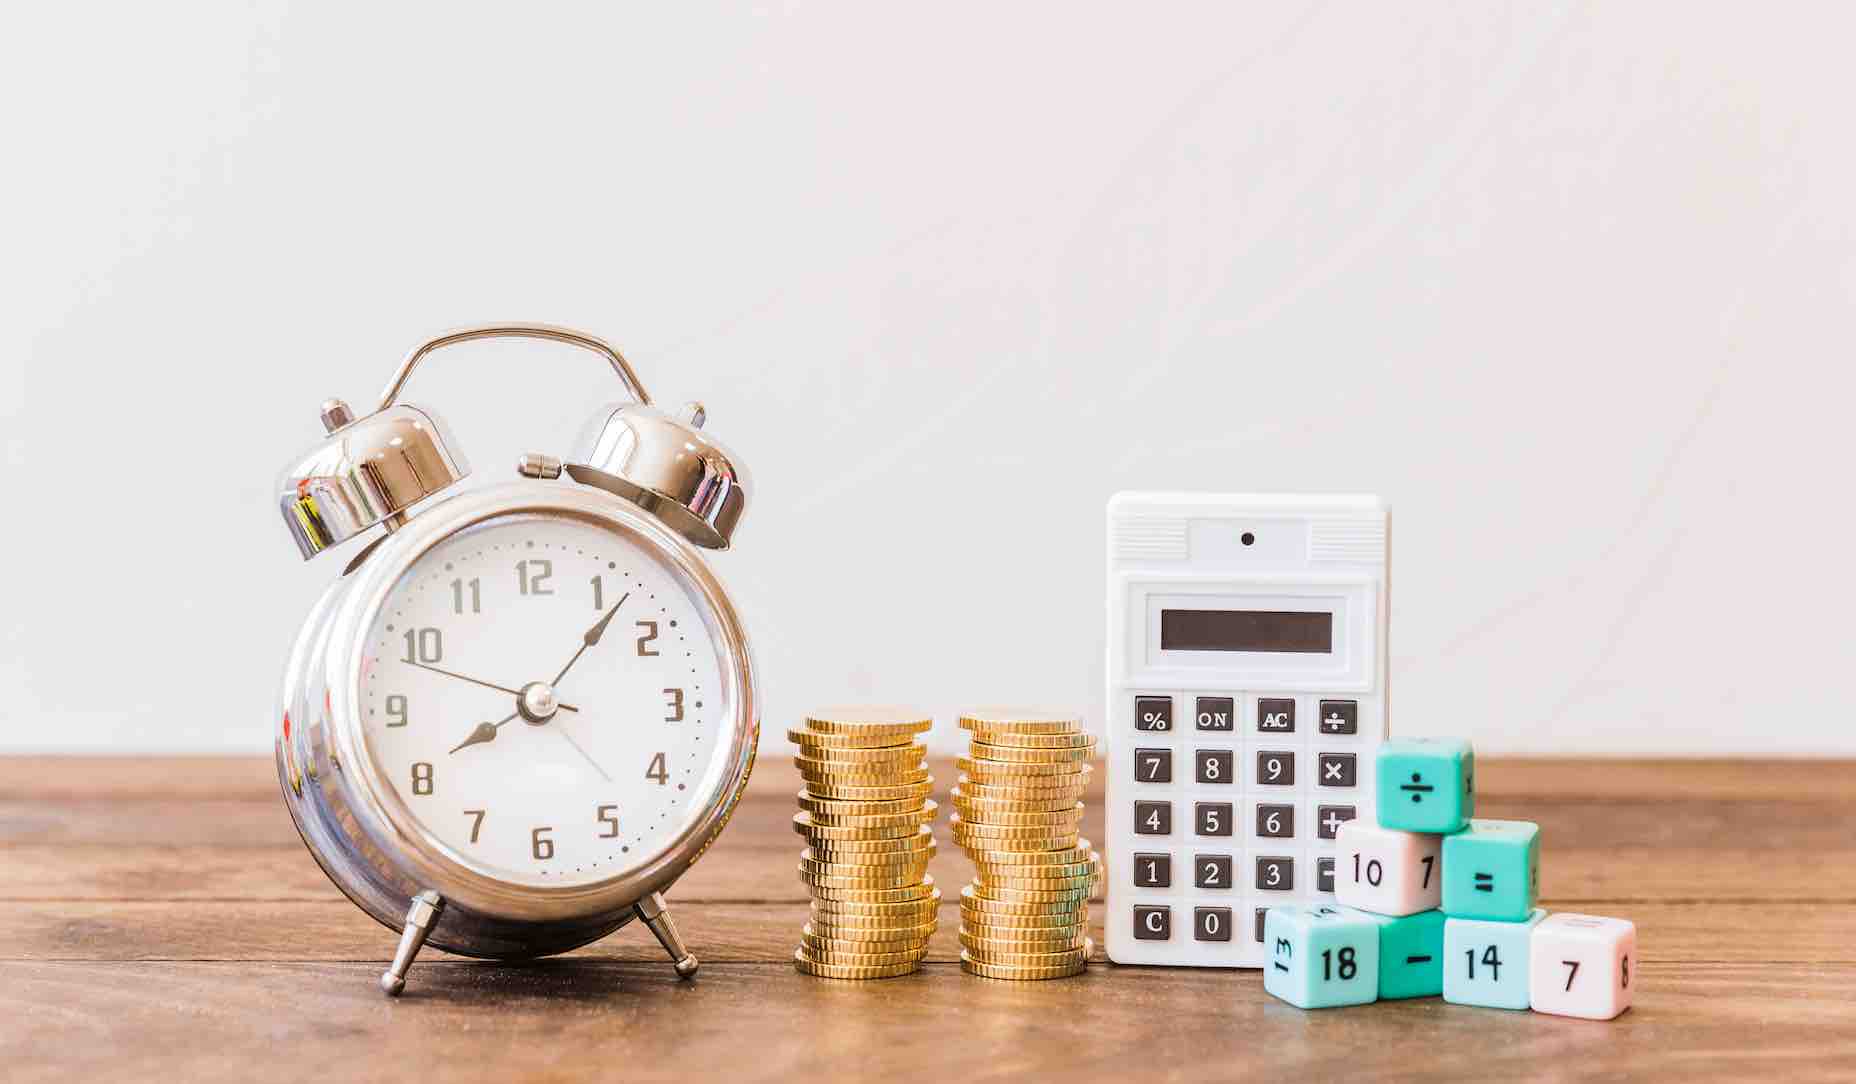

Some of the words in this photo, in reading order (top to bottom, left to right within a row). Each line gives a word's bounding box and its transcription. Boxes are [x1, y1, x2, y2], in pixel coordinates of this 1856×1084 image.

[515, 559, 555, 596] 12
[590, 575, 603, 610] 1
[450, 578, 481, 614] 11
[403, 627, 443, 664] 10
[635, 621, 660, 656] 2
[386, 695, 408, 727] 9
[663, 687, 684, 722] 3
[1198, 712, 1228, 727] ON
[1263, 713, 1288, 728] AC
[1144, 713, 1166, 730] %
[411, 762, 434, 795] 8
[645, 752, 669, 785] 4
[1146, 758, 1161, 779] 7
[1205, 758, 1219, 780] 8
[1267, 758, 1281, 780] 9
[463, 809, 486, 844] 7
[597, 805, 619, 838] 5
[1146, 809, 1160, 831] 4
[1205, 810, 1219, 832] 5
[1266, 812, 1280, 833] 6
[531, 827, 554, 861] 6
[1147, 861, 1157, 882] 1
[1204, 863, 1219, 884] 2
[1266, 864, 1280, 885] 3
[1353, 853, 1382, 887] 10
[1146, 912, 1163, 932] C
[1205, 913, 1219, 934] 0
[1274, 936, 1292, 973] 13
[1322, 946, 1357, 981] 18
[1465, 945, 1502, 981] 14
[1562, 960, 1580, 992] 7
